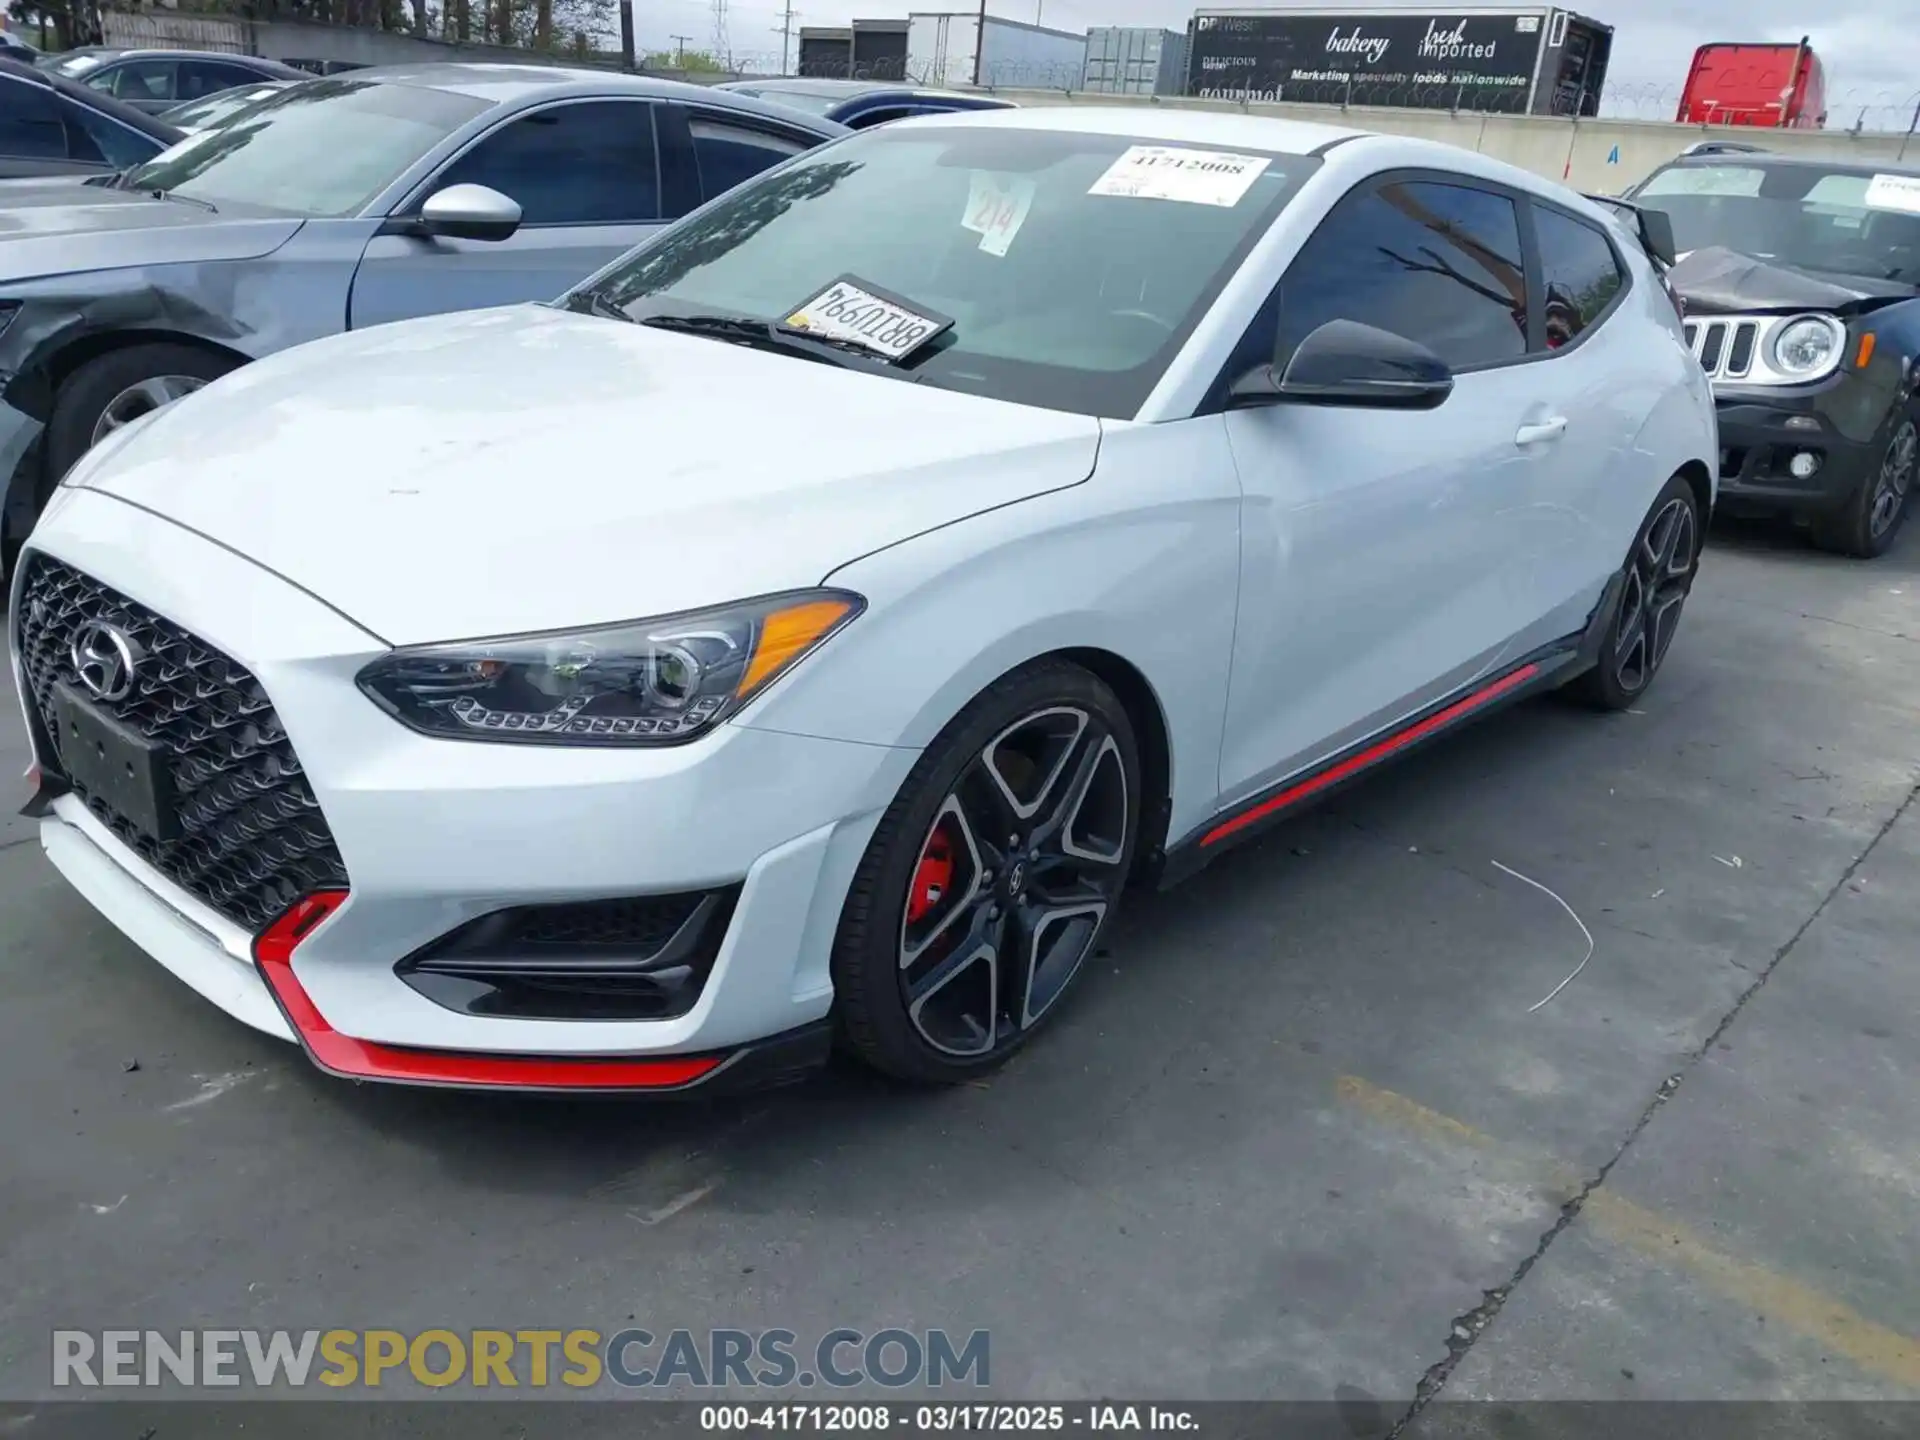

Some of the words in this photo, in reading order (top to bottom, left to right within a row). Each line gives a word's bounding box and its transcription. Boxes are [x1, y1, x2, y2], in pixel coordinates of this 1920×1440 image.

[1326, 26, 1391, 63] bakery
[1418, 40, 1496, 60] imported
[1291, 69, 1350, 83] Marketing
[1412, 72, 1449, 84] foods
[1452, 75, 1527, 86] nationwide
